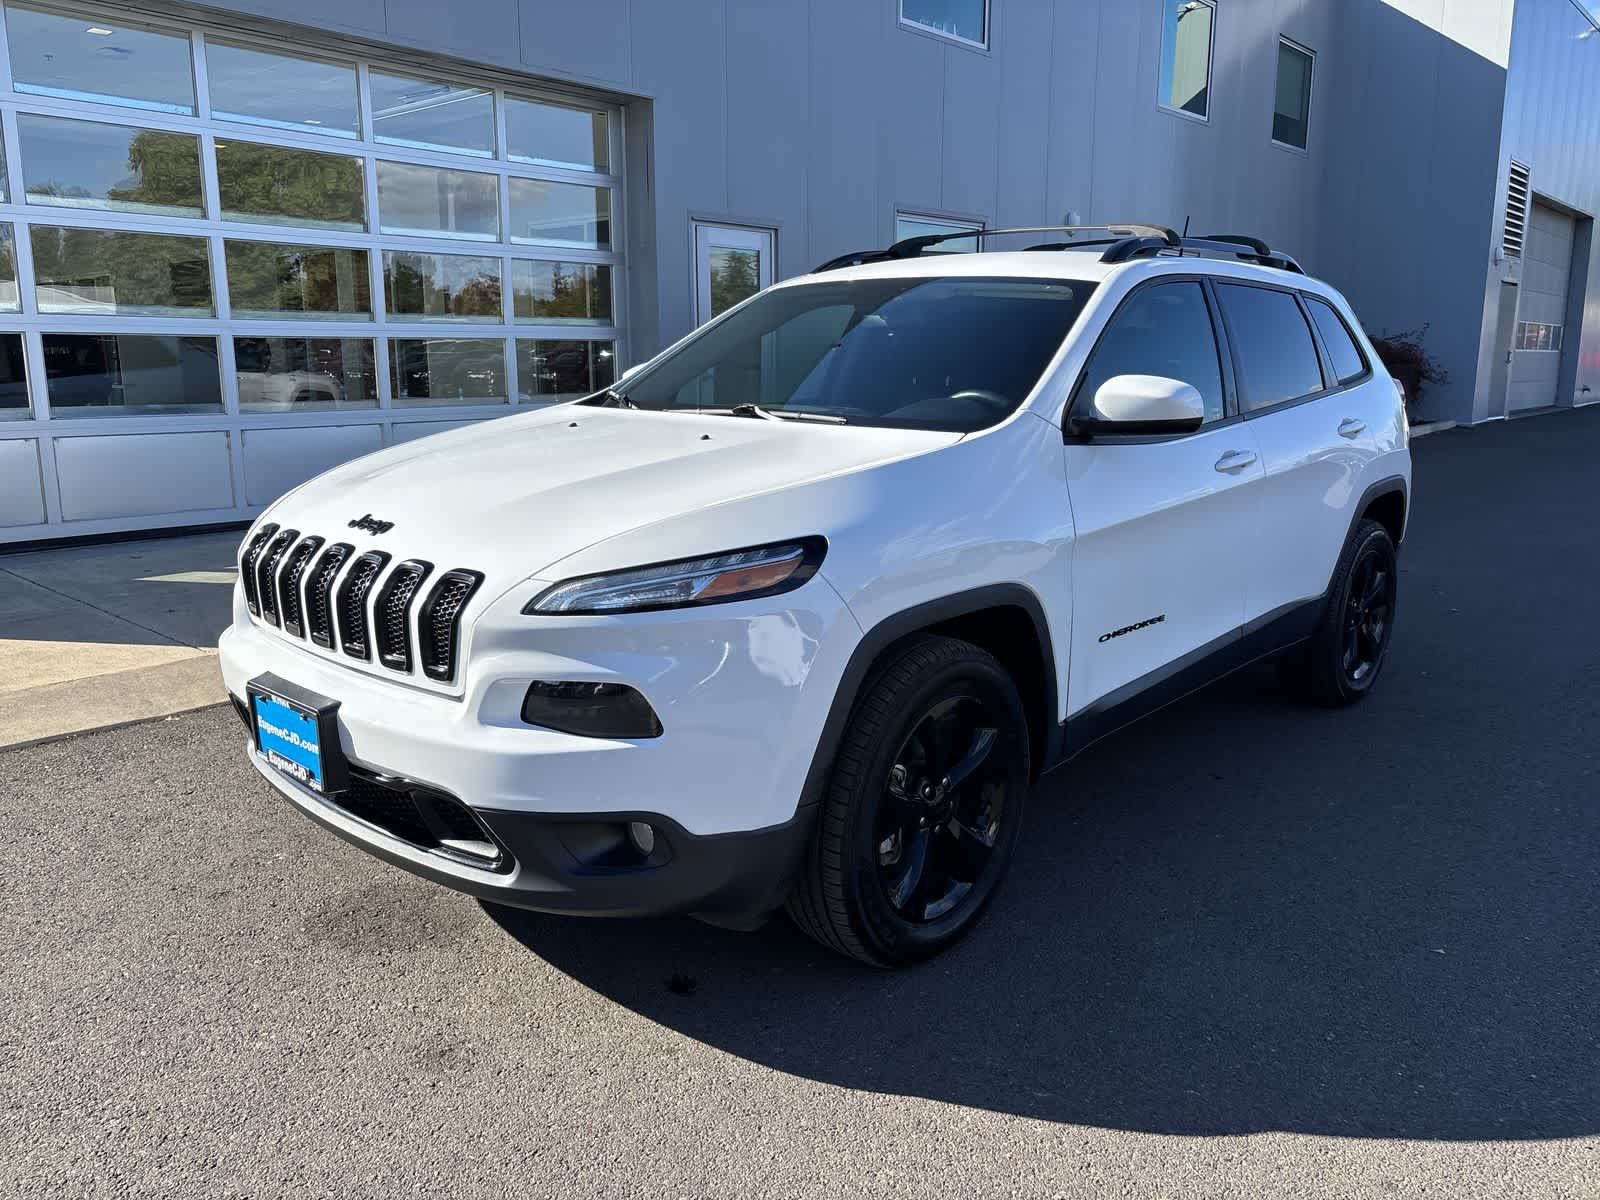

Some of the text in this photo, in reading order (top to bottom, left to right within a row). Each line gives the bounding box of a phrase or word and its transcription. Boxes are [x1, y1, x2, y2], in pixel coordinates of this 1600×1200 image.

[347, 513, 395, 536] Jeep
[1098, 614, 1166, 643] CHEROKEE
[257, 714, 319, 754] EugeneCJD.com
